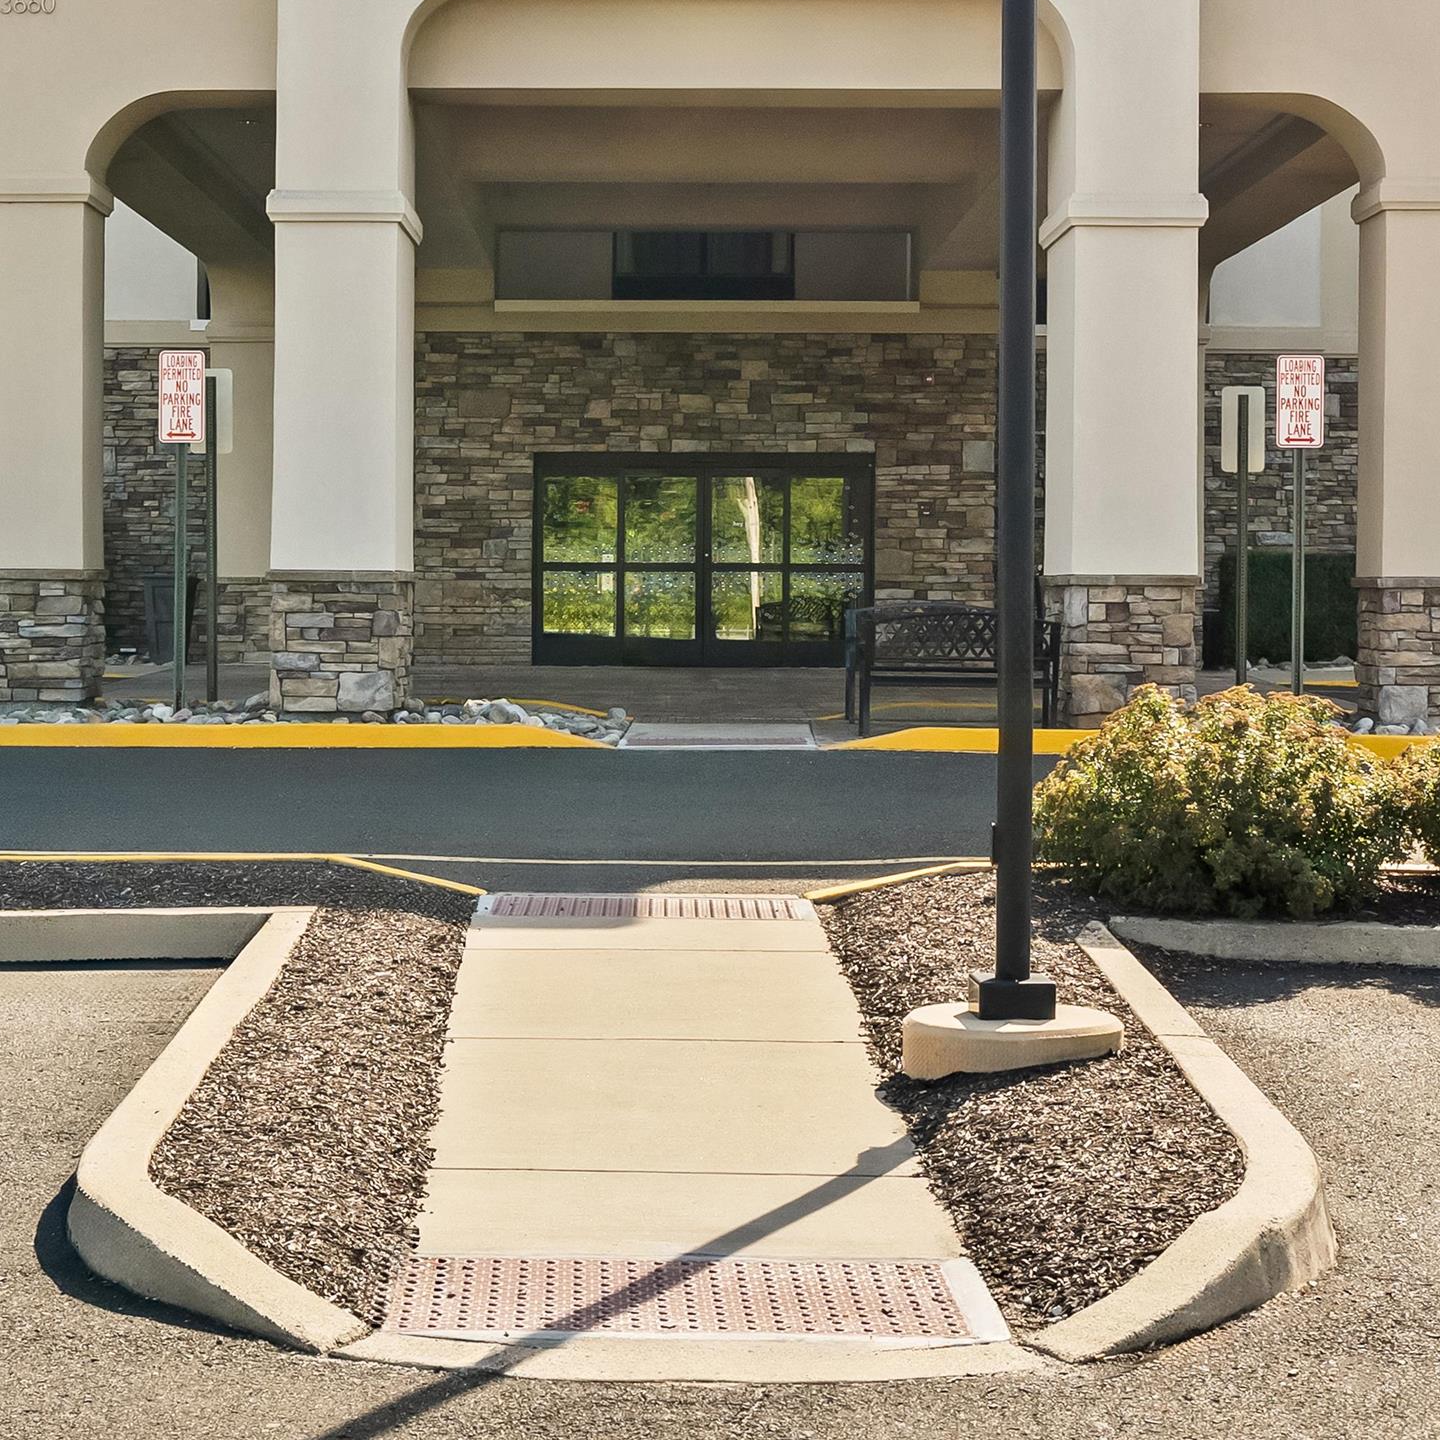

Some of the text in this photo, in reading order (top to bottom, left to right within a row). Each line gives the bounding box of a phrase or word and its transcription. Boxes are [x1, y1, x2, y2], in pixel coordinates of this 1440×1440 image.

[166, 355, 197, 368] LOADING
[1284, 360, 1316, 372] LOADING
[162, 368, 201, 380] PERMITTED
[1280, 373, 1320, 385] PERMITTED
[175, 380, 189, 393] NO
[1293, 385, 1307, 398] NO
[162, 393, 201, 406] PARKING
[1280, 398, 1320, 411] PARKING
[171, 406, 192, 418] FIRE
[1289, 410, 1311, 423] FIRE
[169, 418, 193, 431] LANE
[1287, 423, 1312, 436] LANE
